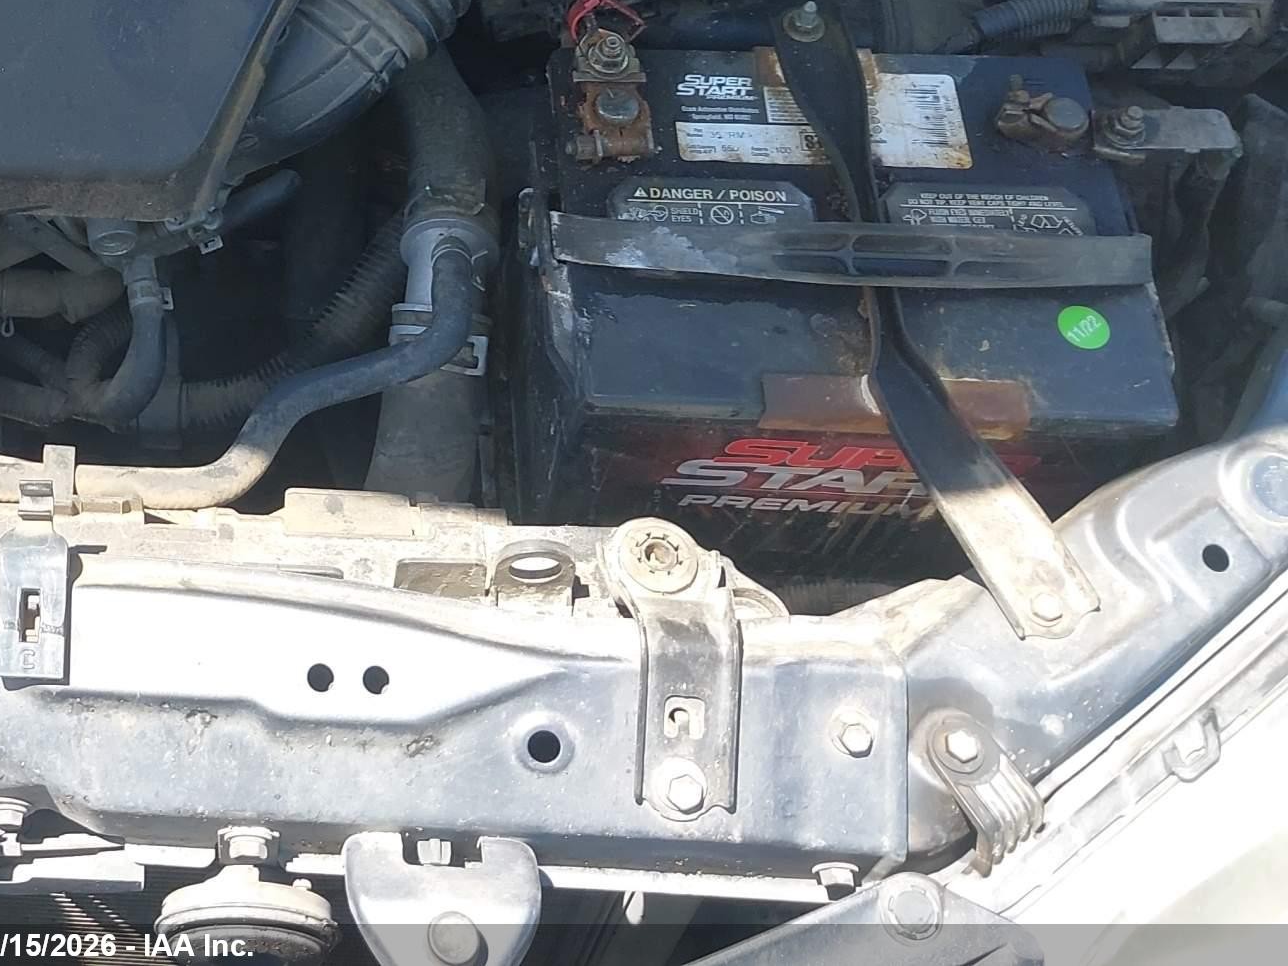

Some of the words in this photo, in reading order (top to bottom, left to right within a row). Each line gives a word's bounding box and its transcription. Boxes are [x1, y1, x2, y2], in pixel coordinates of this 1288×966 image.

[684, 74, 753, 86] SUPER
[676, 83, 754, 96] START
[648, 187, 713, 200] DANGER
[729, 189, 787, 202] POISON
[670, 207, 699, 216] SHIELD
[671, 215, 692, 223] EYES
